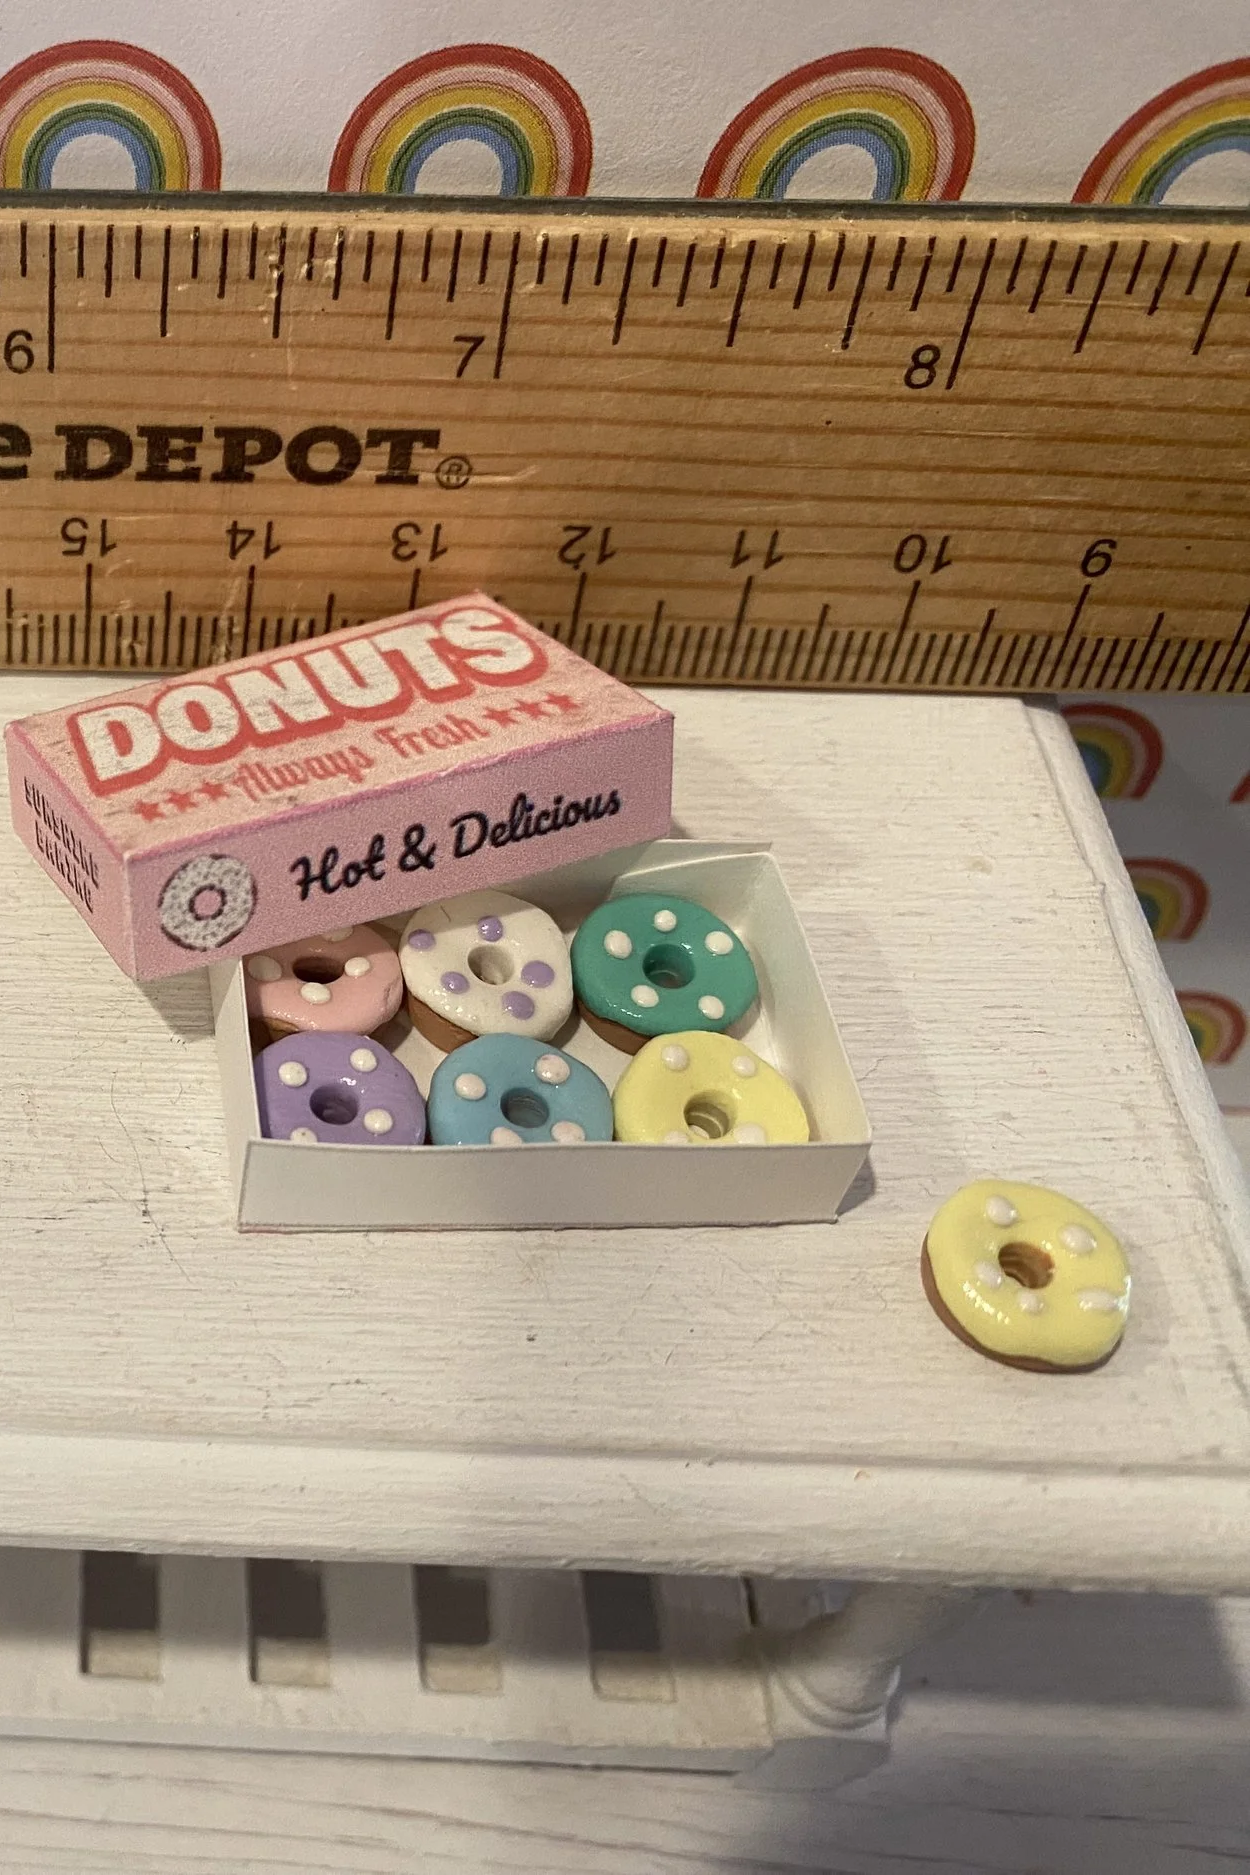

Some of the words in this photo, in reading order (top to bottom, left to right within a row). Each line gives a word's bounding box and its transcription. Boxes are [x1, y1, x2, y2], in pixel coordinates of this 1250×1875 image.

[3, 330, 35, 374] 6
[452, 335, 486, 378] 7
[903, 345, 941, 389] 8
[61, 517, 117, 557] 15
[226, 520, 282, 560] 14
[391, 522, 448, 562] 13
[556, 524, 617, 566] 12
[730, 530, 786, 569] 11
[893, 534, 953, 574] 10
[1080, 538, 1118, 577] 9
[66, 604, 549, 798] DONUTS
[235, 748, 373, 805] Always
[379, 715, 489, 760] Fresh
[291, 836, 385, 900] Hot
[399, 823, 436, 873] &
[451, 789, 622, 859] Delicious
